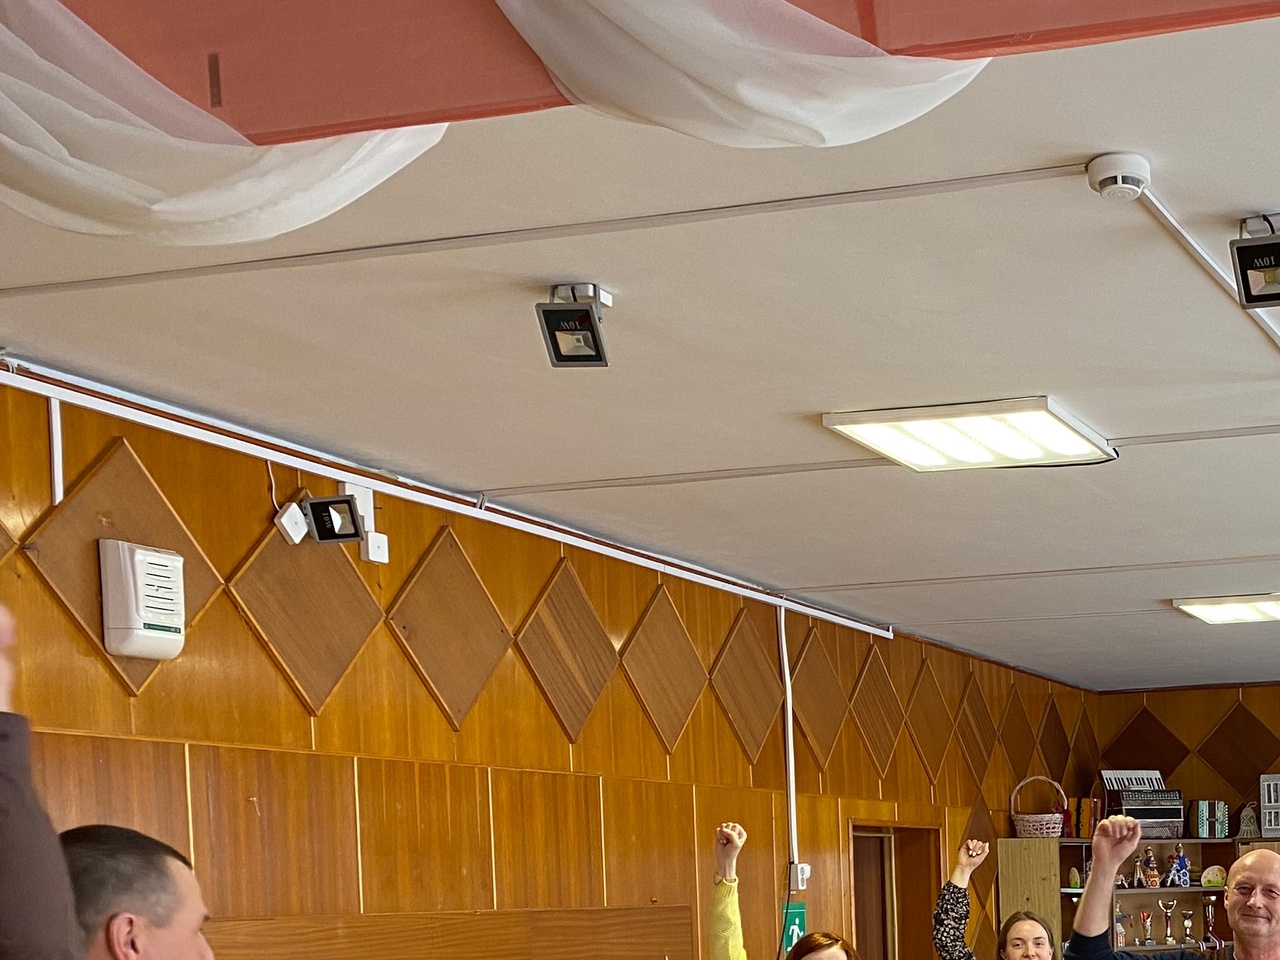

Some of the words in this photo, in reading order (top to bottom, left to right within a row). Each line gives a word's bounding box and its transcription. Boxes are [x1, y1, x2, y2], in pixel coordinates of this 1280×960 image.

[1253, 256, 1275, 267] 10W
[559, 321, 581, 330] 10W
[322, 512, 332, 529] 10W
